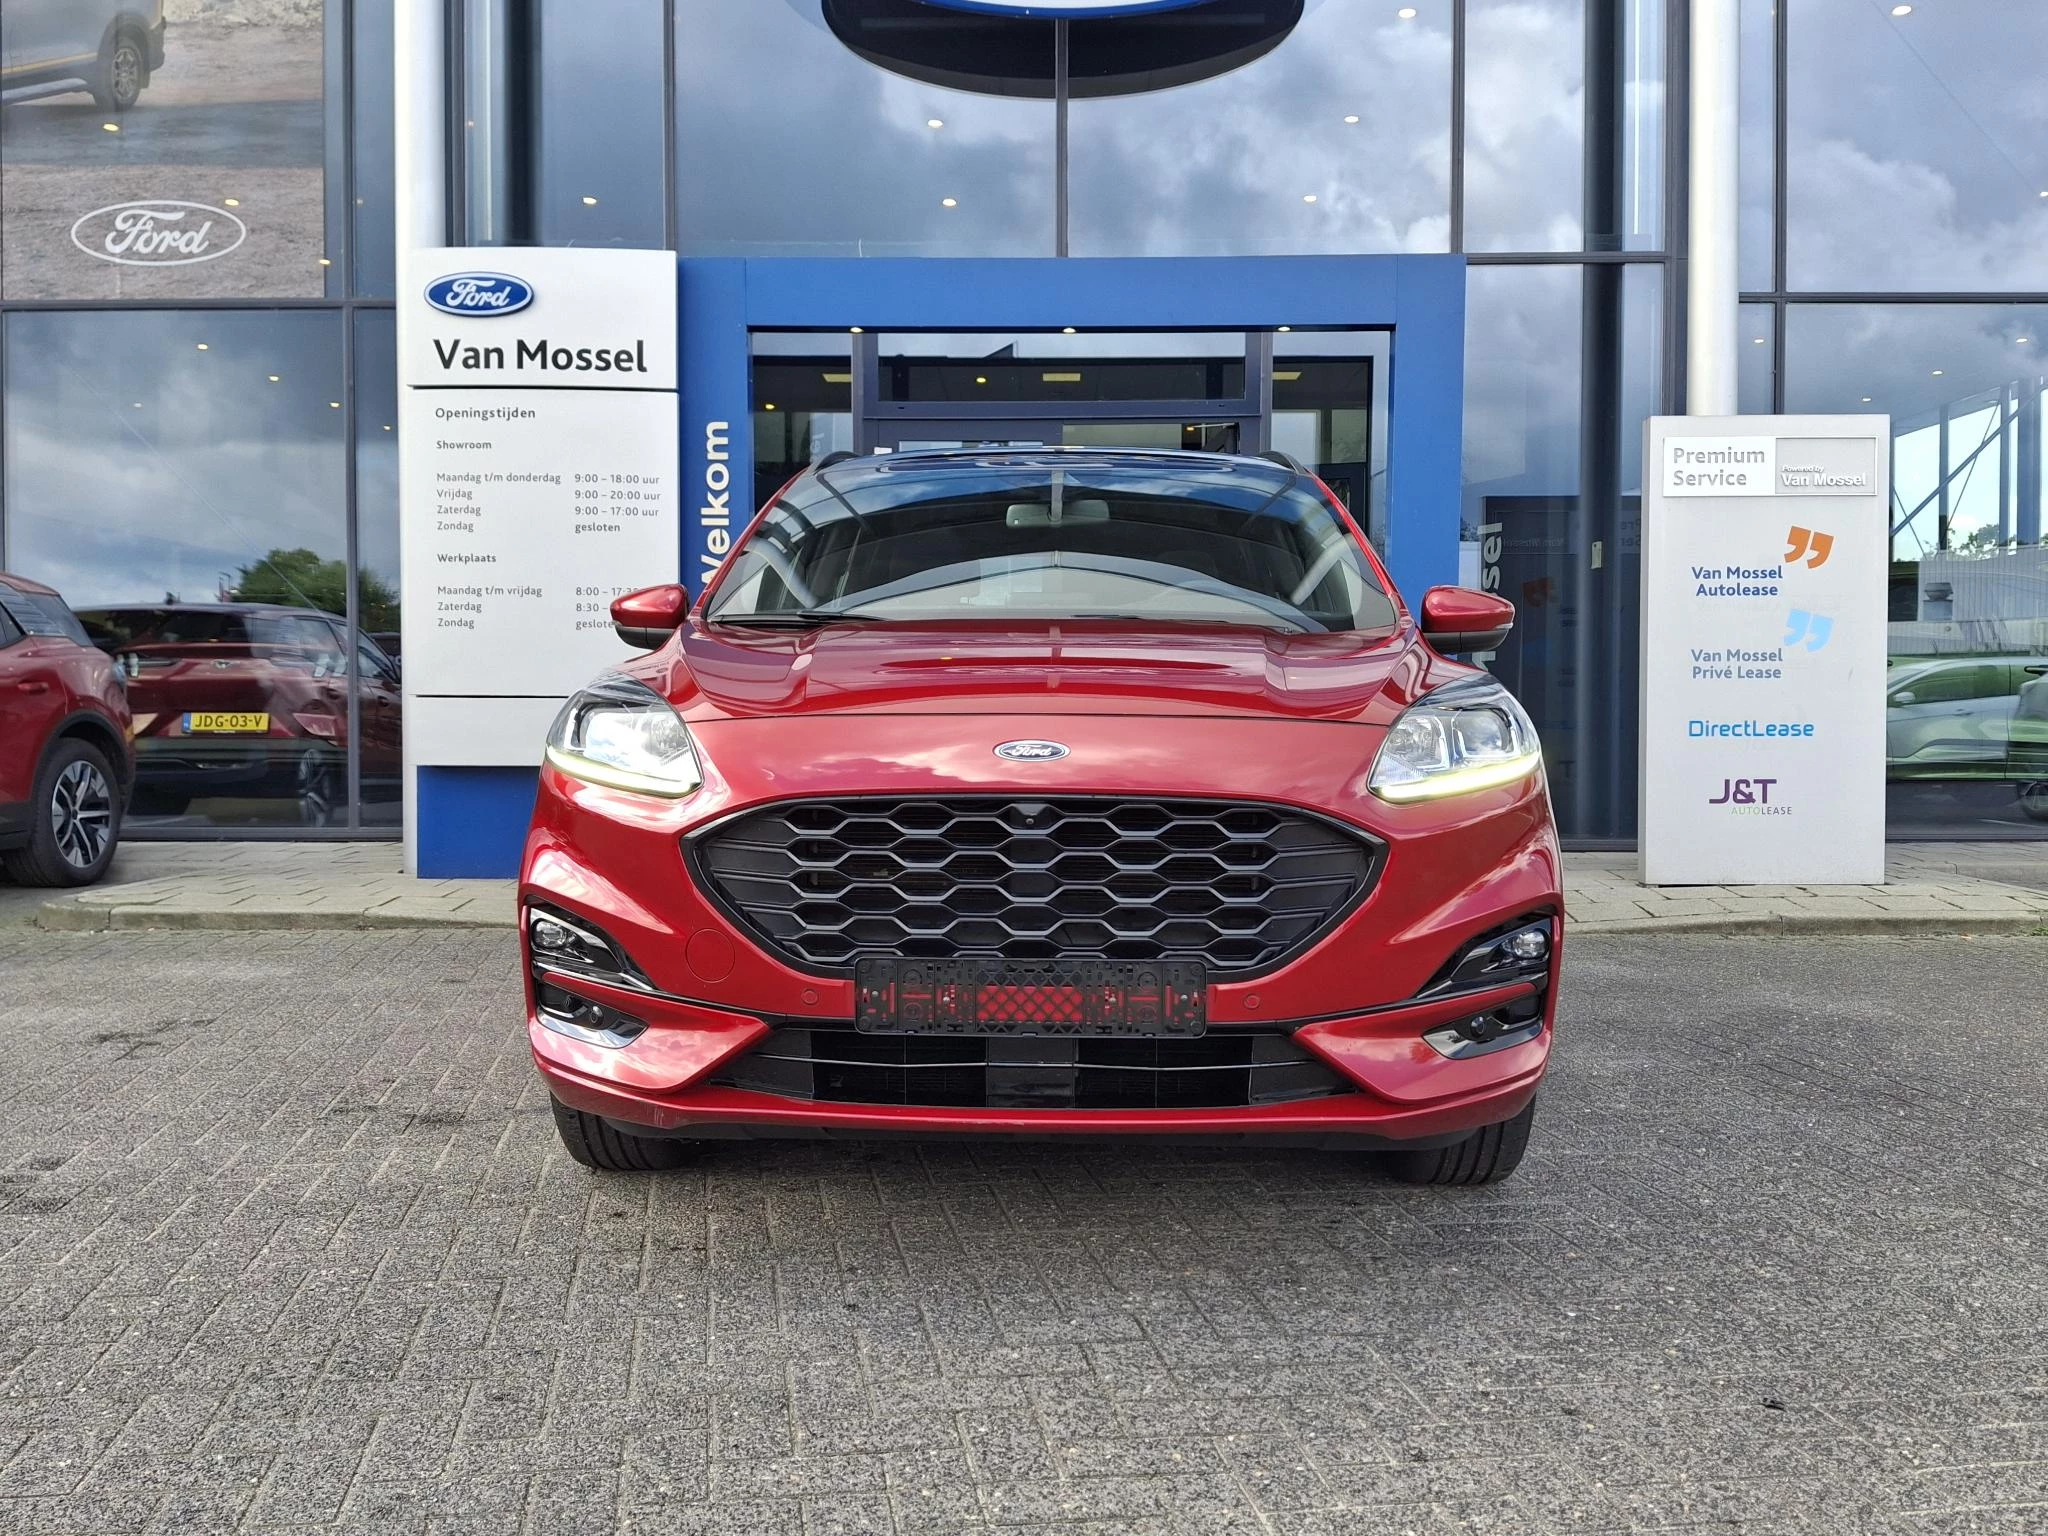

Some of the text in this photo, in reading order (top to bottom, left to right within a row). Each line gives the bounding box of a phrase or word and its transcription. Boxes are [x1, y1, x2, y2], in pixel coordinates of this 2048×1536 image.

[105, 209, 213, 254] Ford
[445, 278, 511, 307] Ford
[433, 339, 648, 373] Van Mossel
[435, 407, 536, 421] Openingstijden
[436, 440, 492, 450] Showroom
[1673, 446, 1765, 464] Premium
[436, 472, 482, 484] Maandag
[484, 473, 504, 483] t/m
[506, 472, 562, 485] donderdag
[574, 474, 599, 484] 9:00
[610, 474, 639, 485] 18:00
[1673, 469, 1747, 486] Service
[1781, 472, 1866, 486] Van Mossel
[436, 488, 473, 501] Vrijdag
[574, 490, 599, 501] 9:00
[610, 490, 641, 501] 20:00
[437, 504, 482, 517] Zaterdag
[574, 506, 599, 517] 9:00
[610, 506, 639, 517] 17:00
[641, 509, 659, 517] uur
[437, 520, 621, 534] Zondag gesloten
[437, 553, 497, 564] Werkplaats
[1691, 565, 1783, 580] Van Mossel
[437, 586, 482, 597] Maandag
[485, 586, 504, 597] t/m
[506, 585, 543, 598] vrijdag
[575, 586, 600, 596] 8:00
[1696, 583, 1779, 597] Autolease
[437, 602, 483, 614] Zaterdag
[575, 603, 600, 612] 8:30
[437, 618, 475, 630] Zondag
[1691, 648, 1783, 662] Van Mossel
[1692, 665, 1782, 679] Privé Lease
[195, 715, 263, 728] JDG-03-V
[1689, 720, 1815, 737] DirectLease
[1010, 744, 1052, 756] Ford
[1709, 779, 1777, 804] J&T
[1731, 806, 1793, 815] AUTOLEASE
